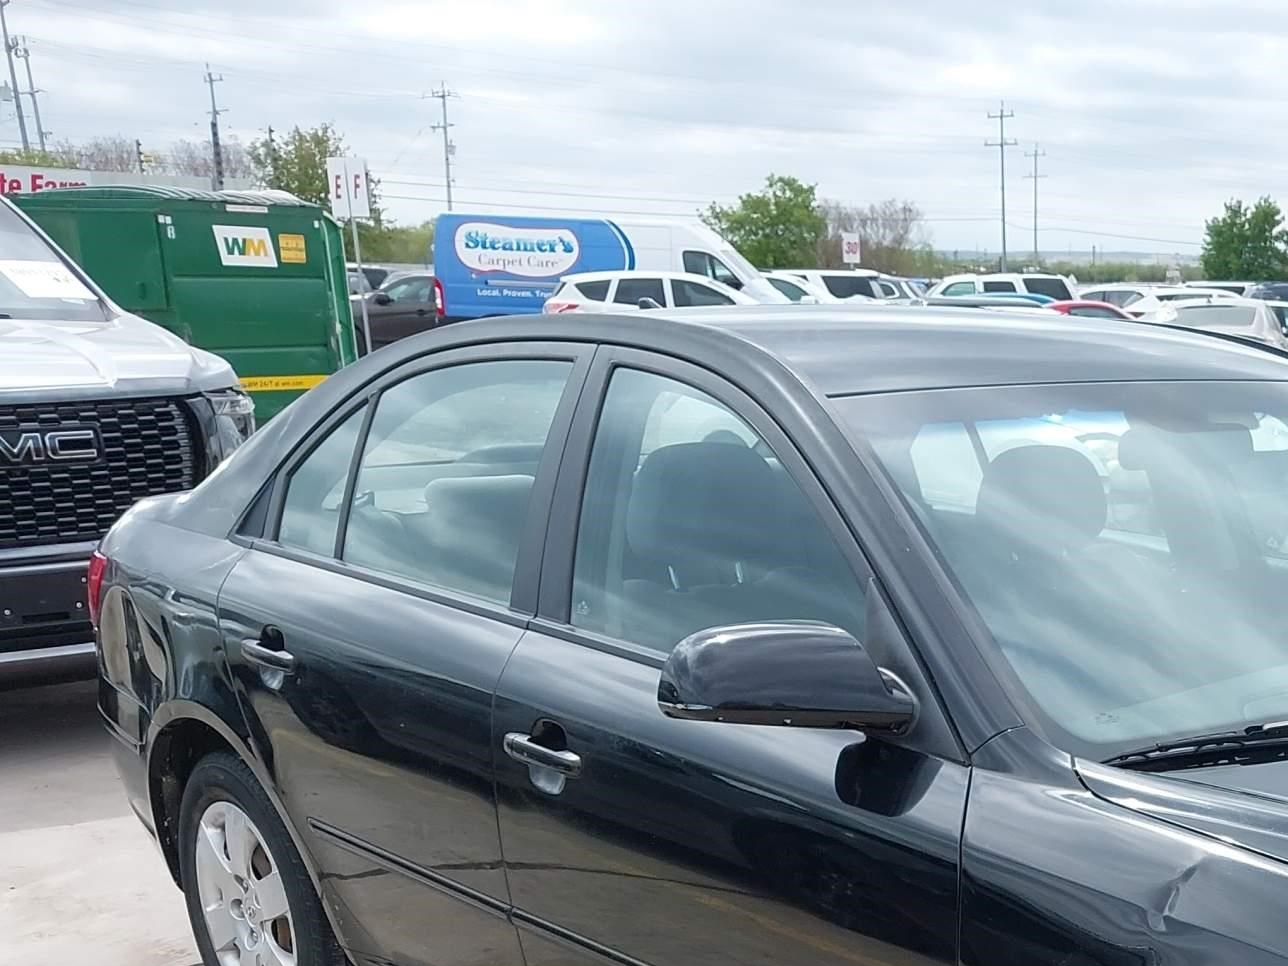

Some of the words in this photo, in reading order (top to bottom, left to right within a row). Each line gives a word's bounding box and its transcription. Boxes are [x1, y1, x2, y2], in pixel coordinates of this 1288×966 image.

[31, 174, 87, 192] Fa
[335, 174, 341, 199] E
[354, 174, 360, 199] F
[223, 236, 268, 257] WM
[464, 231, 574, 253] Steamer's
[478, 254, 522, 269] Carpet
[477, 288, 500, 297] Local.
